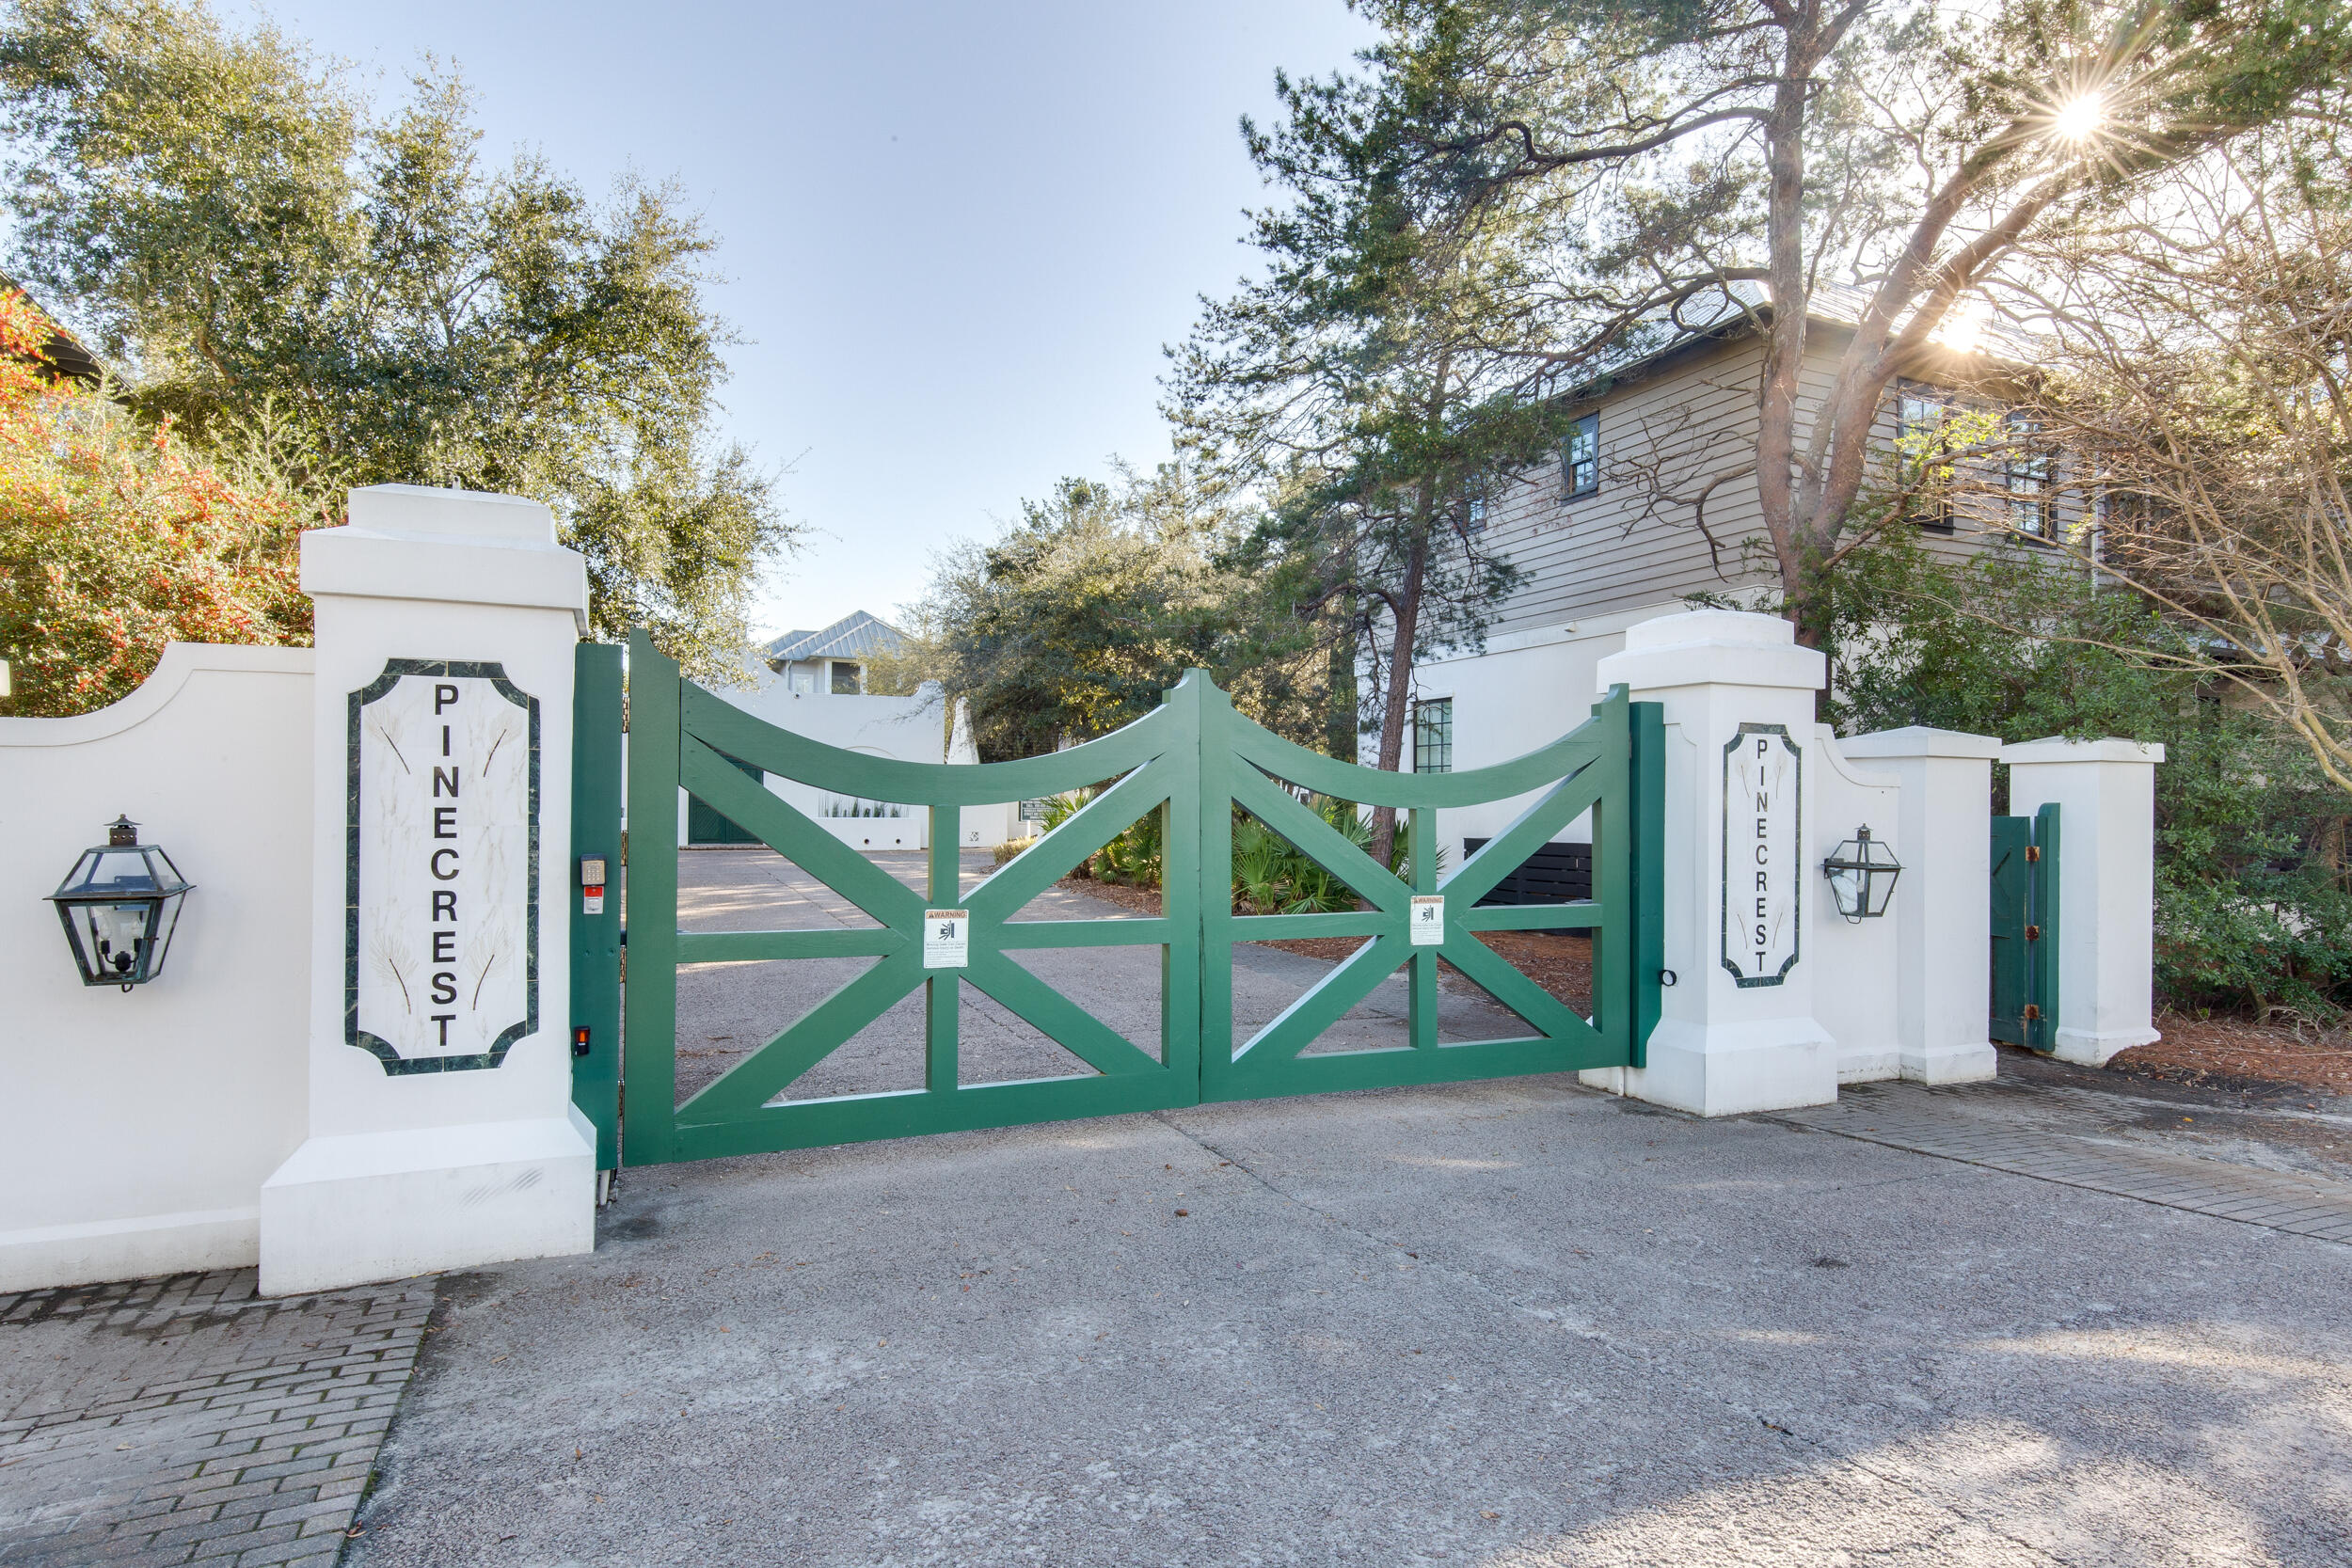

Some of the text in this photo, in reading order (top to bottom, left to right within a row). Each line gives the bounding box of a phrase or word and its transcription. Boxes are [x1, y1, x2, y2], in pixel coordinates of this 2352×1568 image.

[431, 684, 459, 1046] PINECREST
[934, 911, 965, 919] WARNING
[1756, 739, 1768, 972] PINECREST
